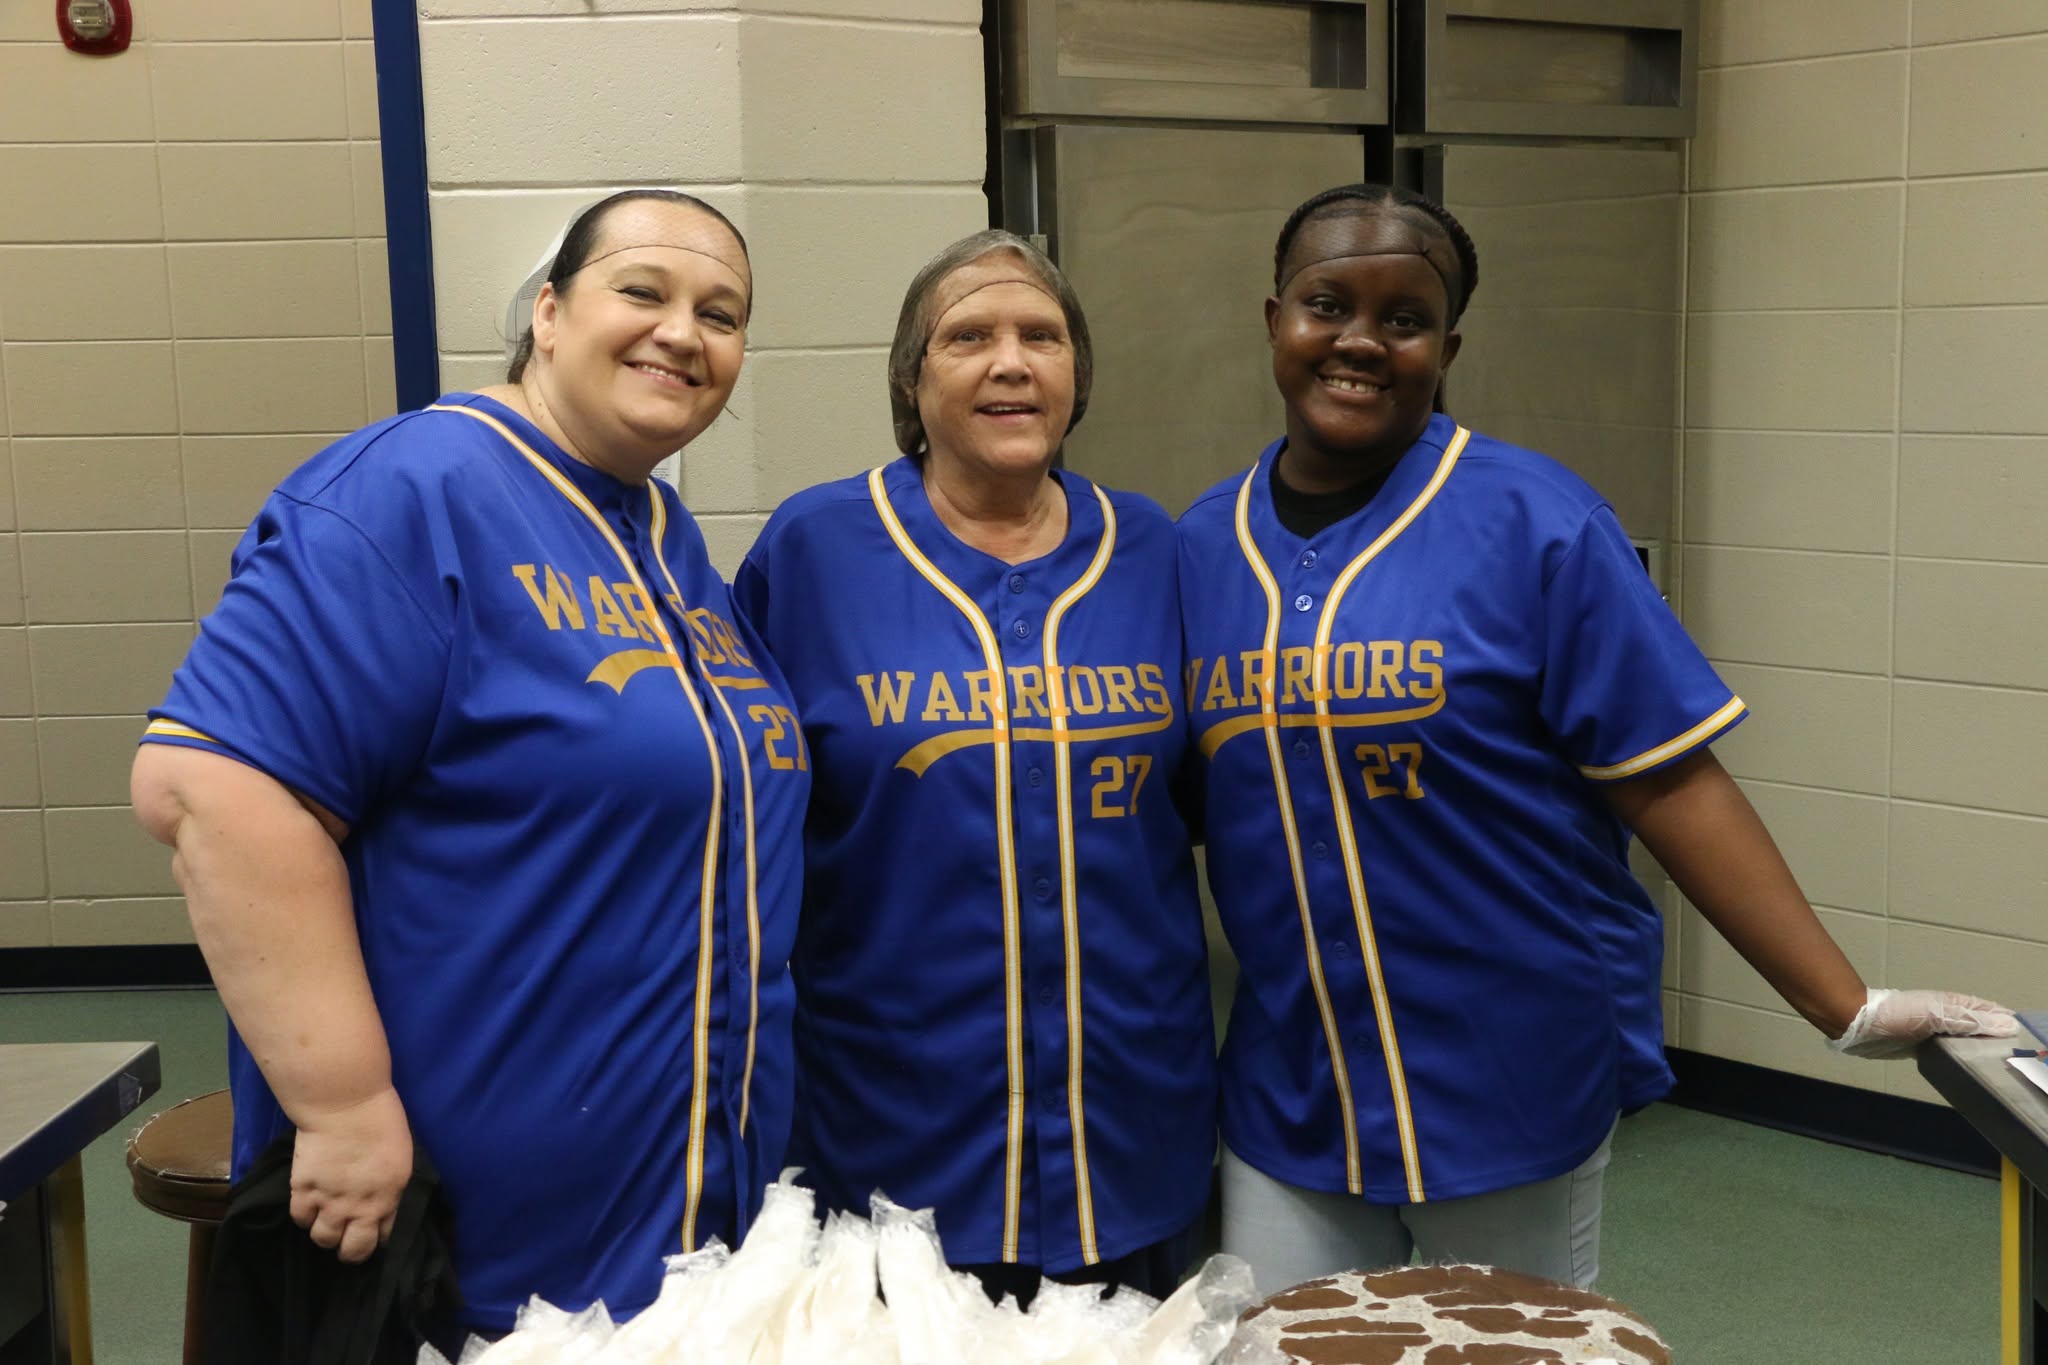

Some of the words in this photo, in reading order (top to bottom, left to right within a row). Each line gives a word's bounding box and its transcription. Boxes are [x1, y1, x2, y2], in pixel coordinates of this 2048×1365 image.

[512, 564, 757, 671] WARORS
[856, 663, 1170, 727] WARRIORS
[747, 704, 808, 772] 27
[1090, 755, 1153, 818] 27
[1354, 743, 1425, 800] 27
